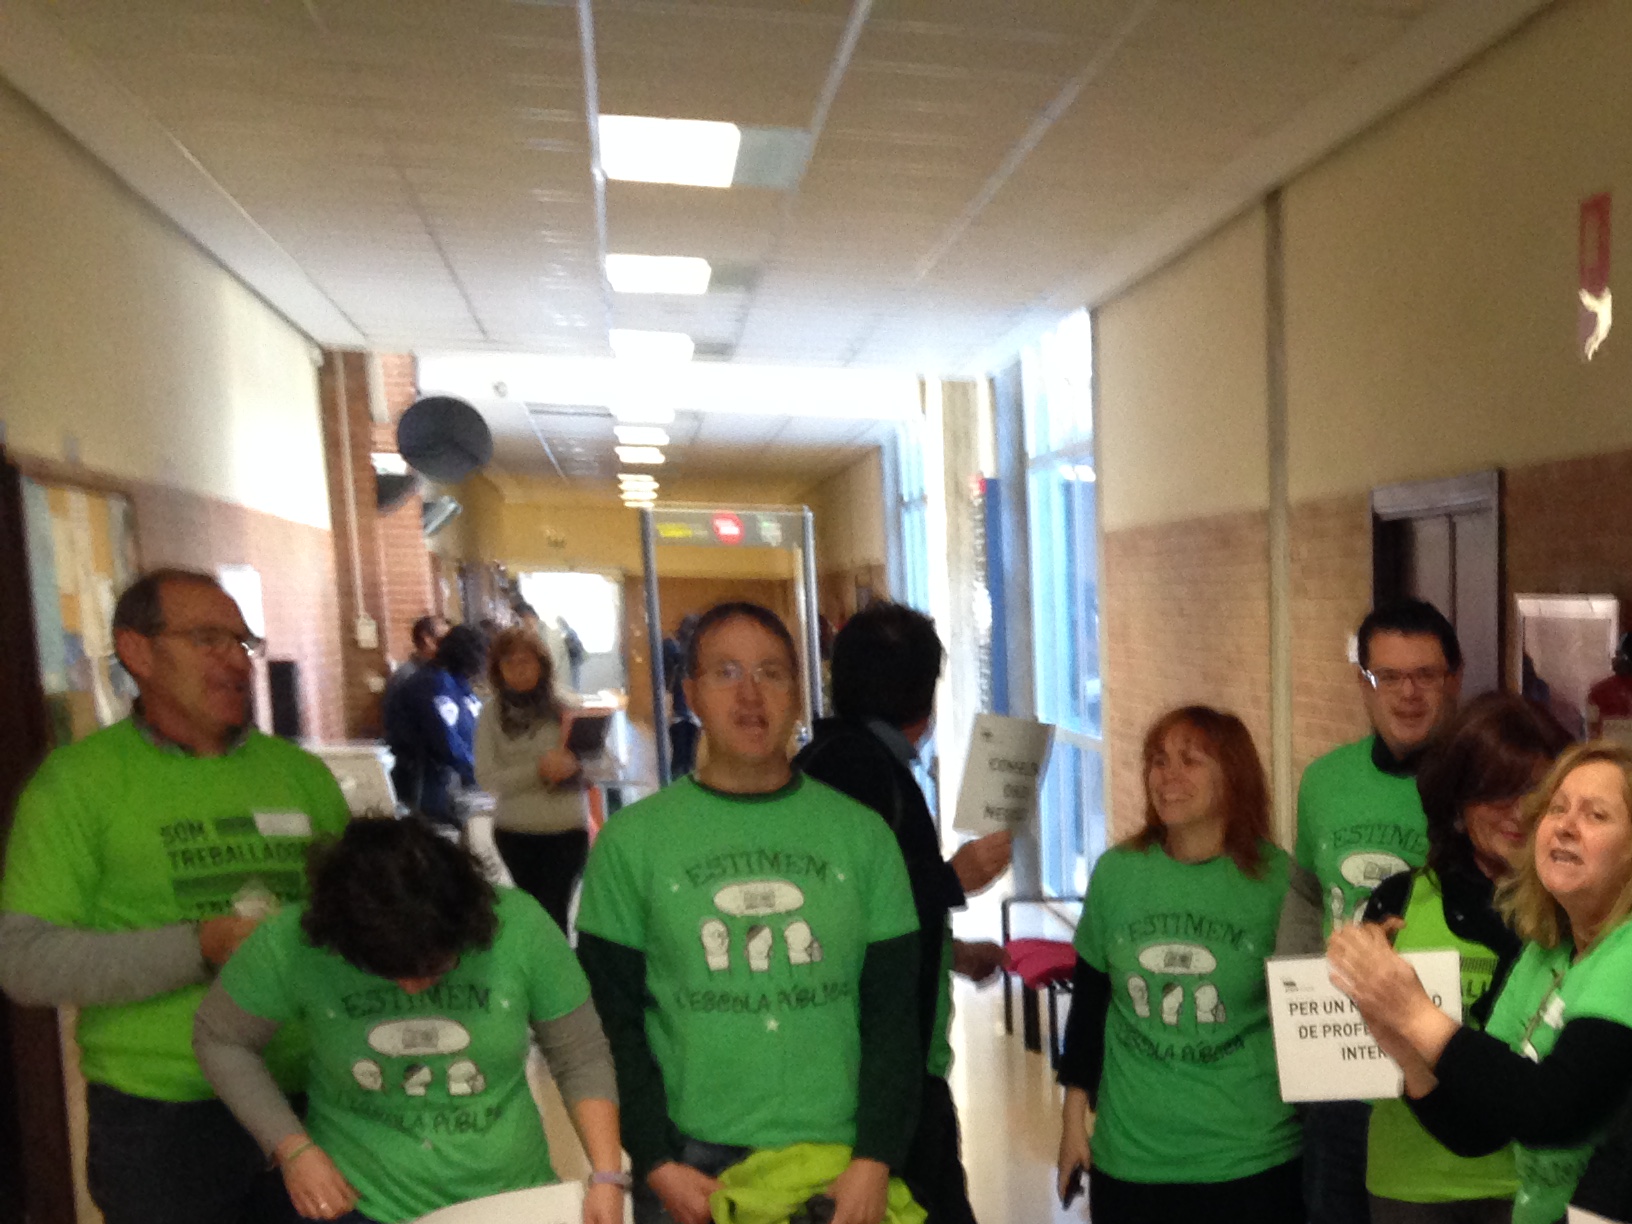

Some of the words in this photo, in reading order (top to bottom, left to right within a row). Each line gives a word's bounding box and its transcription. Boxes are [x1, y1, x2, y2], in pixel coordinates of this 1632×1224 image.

[685, 850, 829, 888] ESTIMEM
[1129, 913, 1245, 949] ESTIMEM
[1289, 1001, 1319, 1016] PER
[1323, 1000, 1345, 1014] UN
[1299, 1025, 1318, 1039] DE
